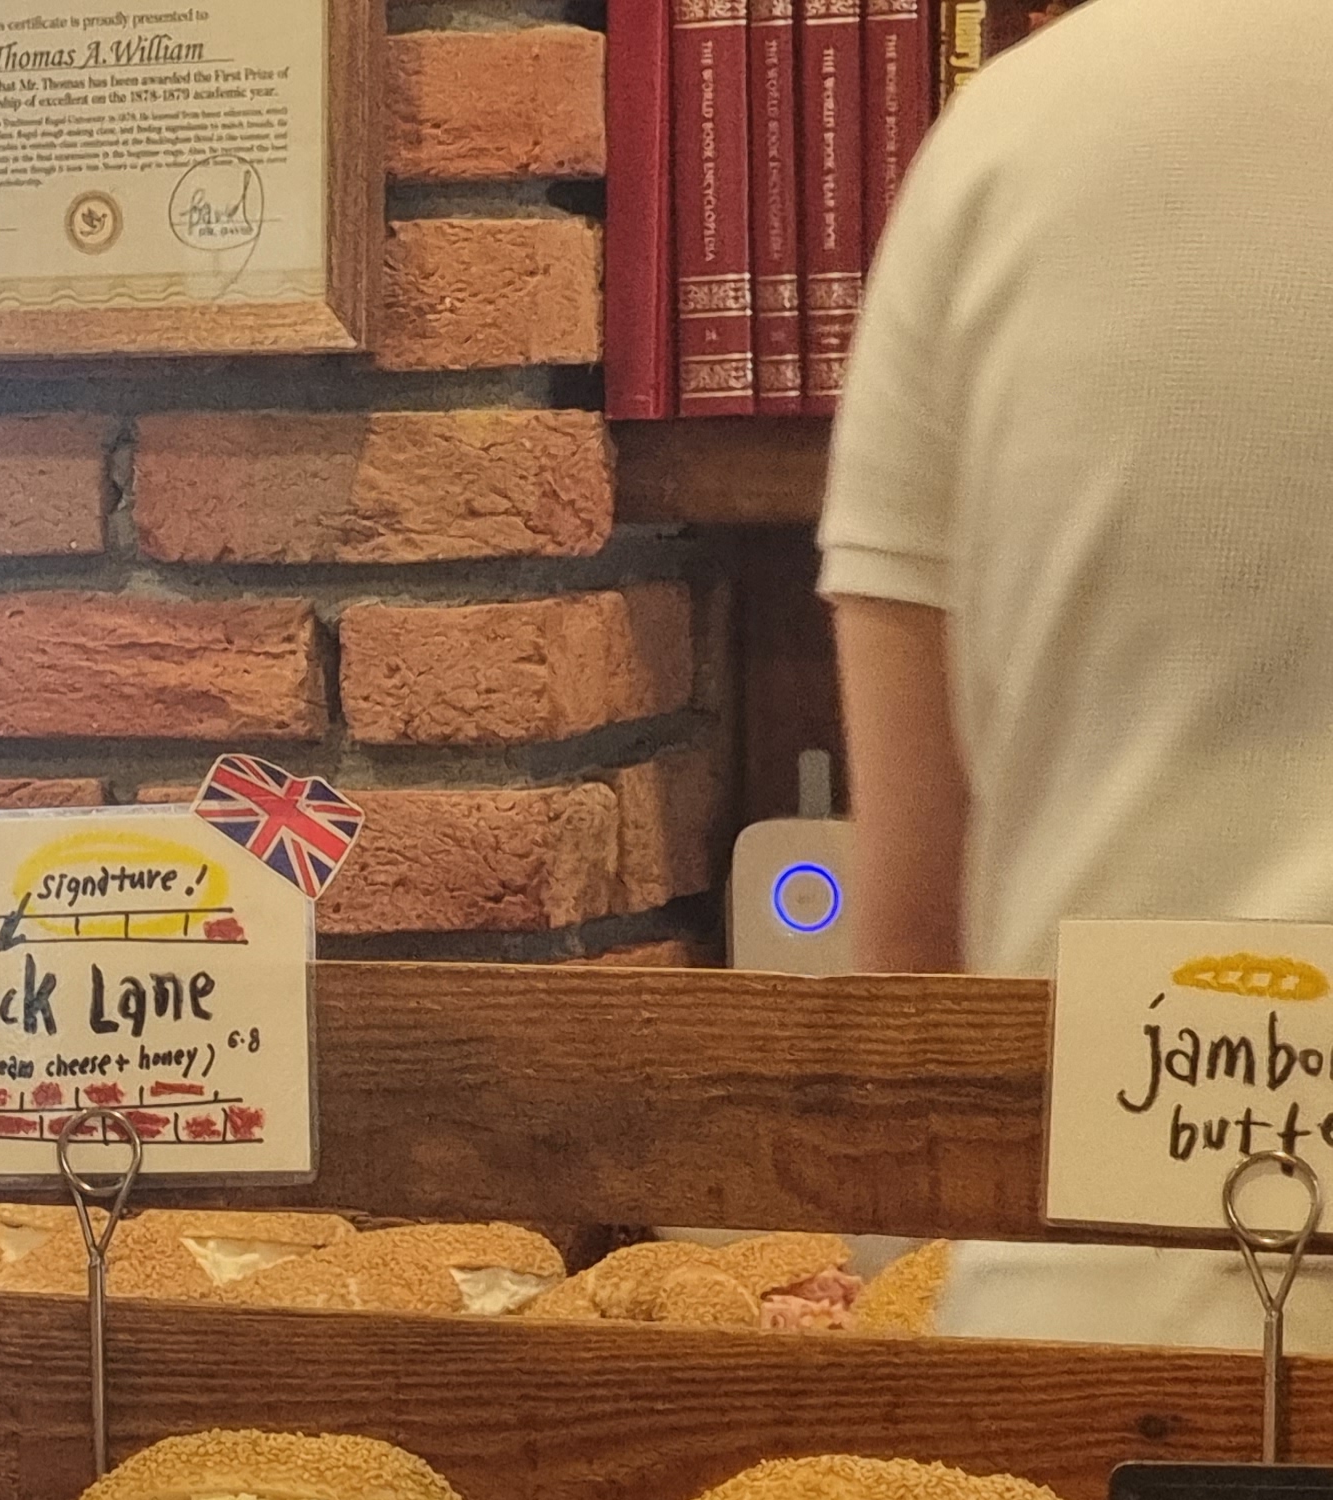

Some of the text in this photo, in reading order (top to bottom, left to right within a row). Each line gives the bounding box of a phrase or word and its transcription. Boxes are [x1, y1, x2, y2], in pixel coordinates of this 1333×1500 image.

[7, 15, 68, 31] certificate
[70, 15, 81, 28] is
[83, 11, 128, 31] proudly
[132, 8, 194, 29] presented
[195, 10, 209, 21] to
[700, 40, 713, 64] THE
[19, 79, 39, 92] Mr.
[41, 77, 86, 91] Thomas
[88, 76, 108, 88] has
[110, 75, 139, 87] been
[141, 72, 191, 86] awarded
[193, 71, 213, 83] the
[214, 69, 243, 82] First
[244, 67, 275, 81] Prize
[277, 66, 290, 79] of
[700, 69, 714, 118] WORLD
[765, 69, 779, 117] WORLD
[885, 62, 897, 112] WORLD
[24, 94, 37, 107] of
[108, 92, 127, 104] the
[823, 77, 836, 128] WORLD
[701, 121, 715, 159] BOOK
[823, 131, 835, 170] BOOK
[89, 962, 216, 1039] Lane
[227, 1028, 262, 1053] 6.8
[1116, 992, 1333, 1114] jambo
